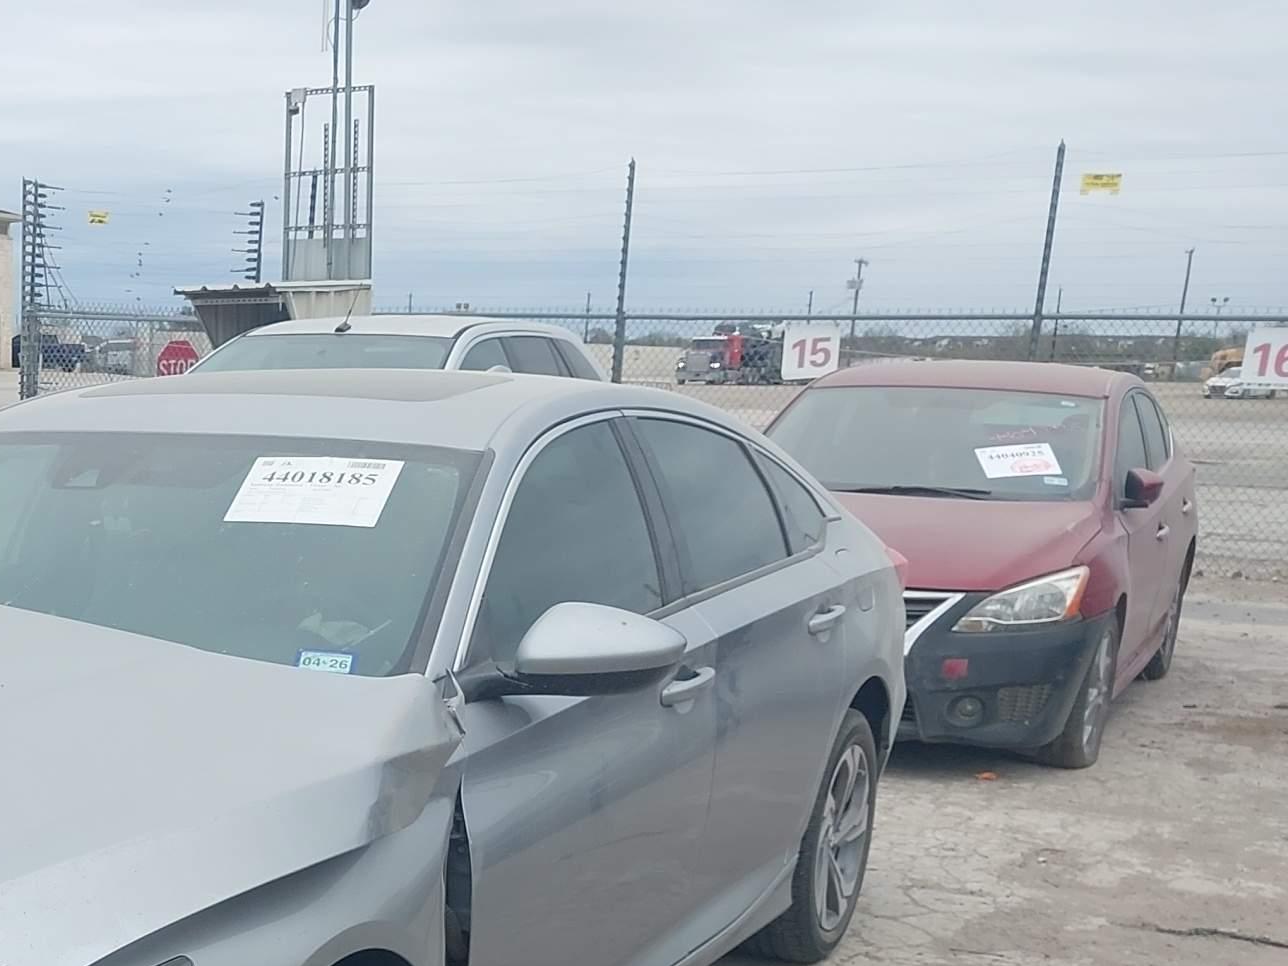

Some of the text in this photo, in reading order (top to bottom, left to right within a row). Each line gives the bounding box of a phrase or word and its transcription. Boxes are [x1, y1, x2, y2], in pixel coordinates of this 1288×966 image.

[792, 336, 832, 369] 15
[1253, 342, 1288, 378] 16
[262, 470, 379, 487] 44018185
